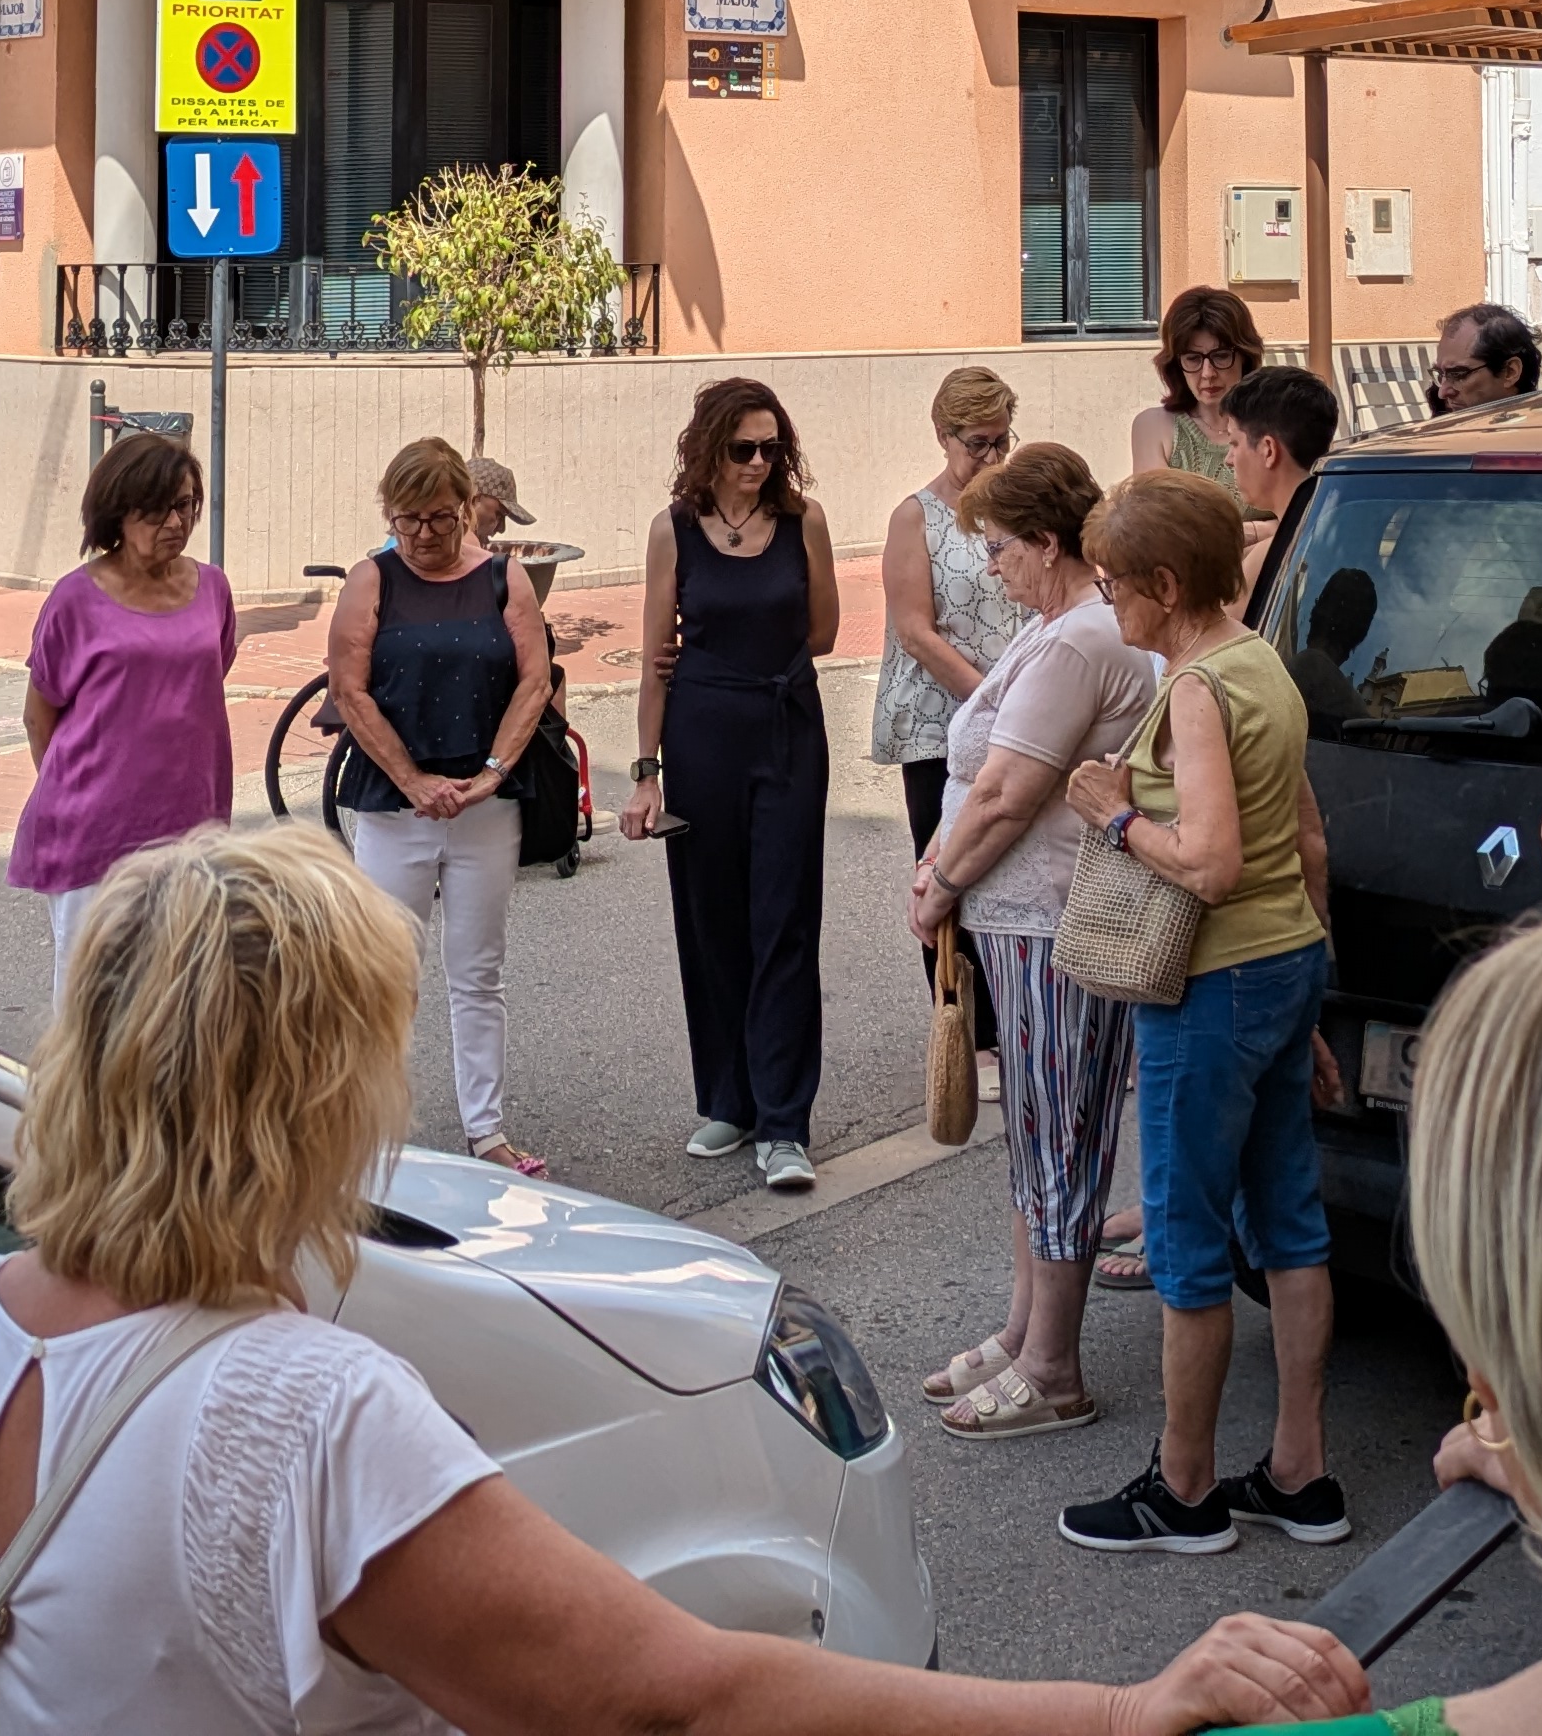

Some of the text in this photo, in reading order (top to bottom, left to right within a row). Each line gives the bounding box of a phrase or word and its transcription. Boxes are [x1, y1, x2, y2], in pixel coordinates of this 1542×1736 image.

[172, 3, 285, 20] PRIORITAT
[170, 97, 286, 108] DISSABTES DE
[193, 108, 202, 116] 6
[209, 108, 220, 117] A
[228, 109, 244, 117] 14
[177, 117, 279, 128] PER MERCAT
